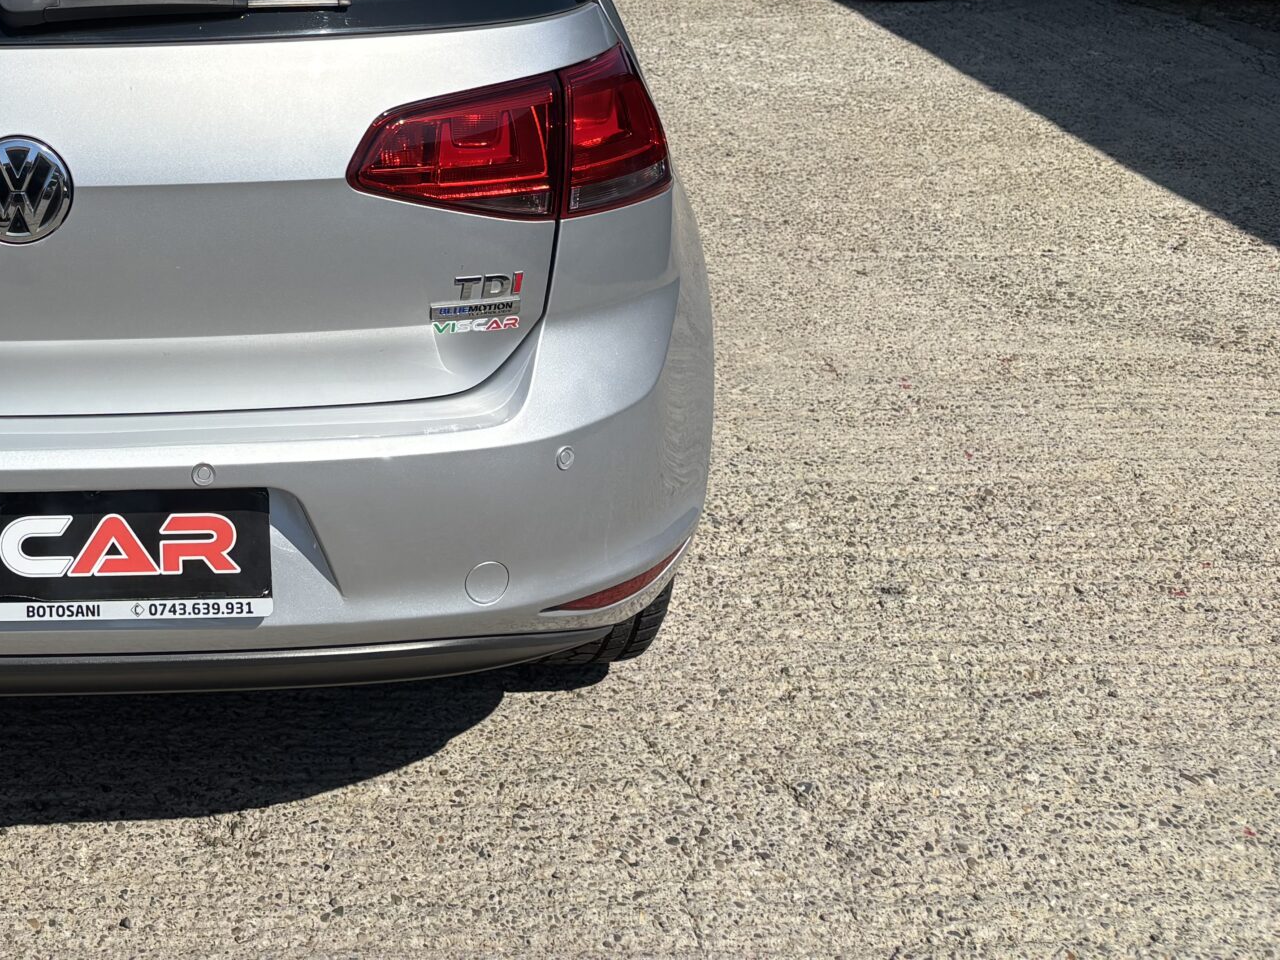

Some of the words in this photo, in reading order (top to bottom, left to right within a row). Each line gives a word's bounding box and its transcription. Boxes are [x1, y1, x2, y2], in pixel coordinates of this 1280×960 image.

[454, 270, 524, 300] TDI
[439, 302, 513, 315] BLUEMOTION
[433, 315, 520, 334] VISCAR
[26, 604, 101, 618] BOTOSANI
[148, 601, 254, 616] 0743.639.931
